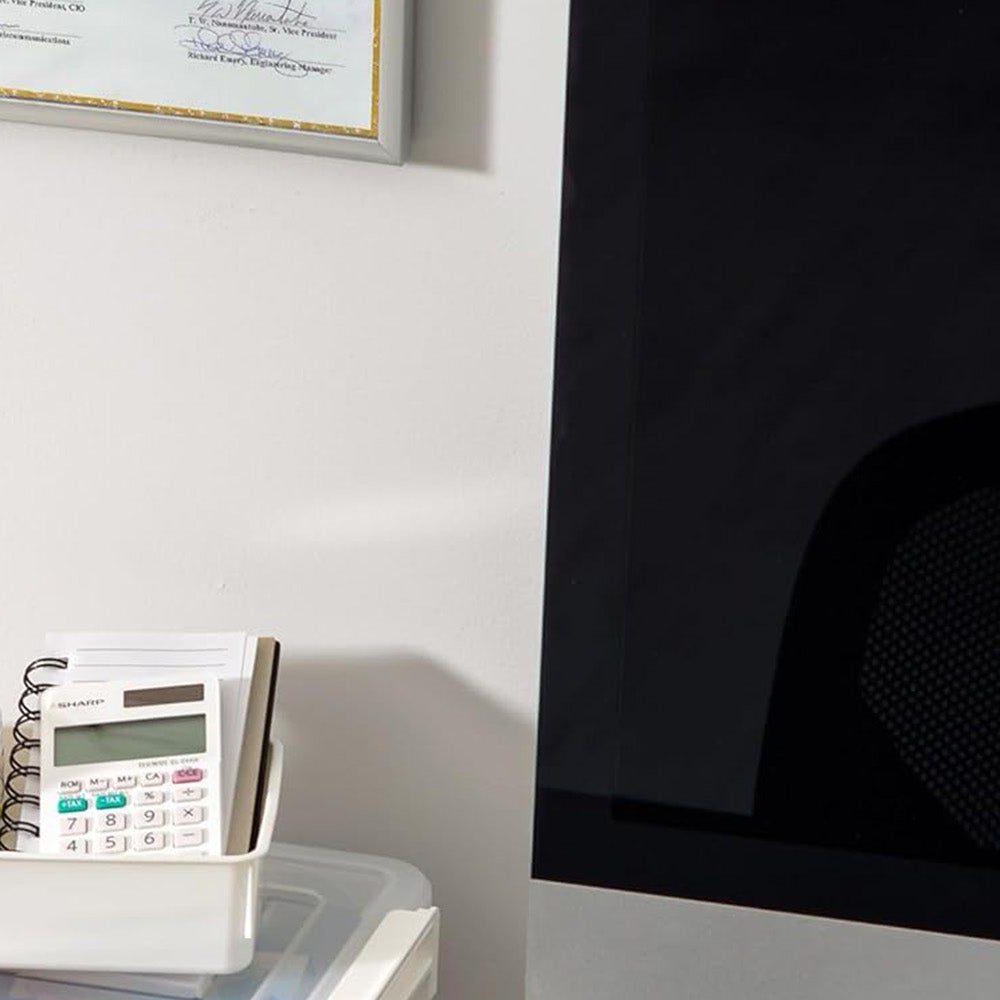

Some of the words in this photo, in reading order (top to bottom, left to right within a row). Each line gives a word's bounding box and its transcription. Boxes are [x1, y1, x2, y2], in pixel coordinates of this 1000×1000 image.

[57, 698, 105, 709] SHARP
[145, 772, 160, 781] CA
[105, 813, 116, 826] 8
[144, 809, 155, 823] 9
[67, 817, 77, 830] 7
[105, 836, 116, 848] 5
[144, 832, 155, 845] 6
[67, 840, 77, 851] 4
